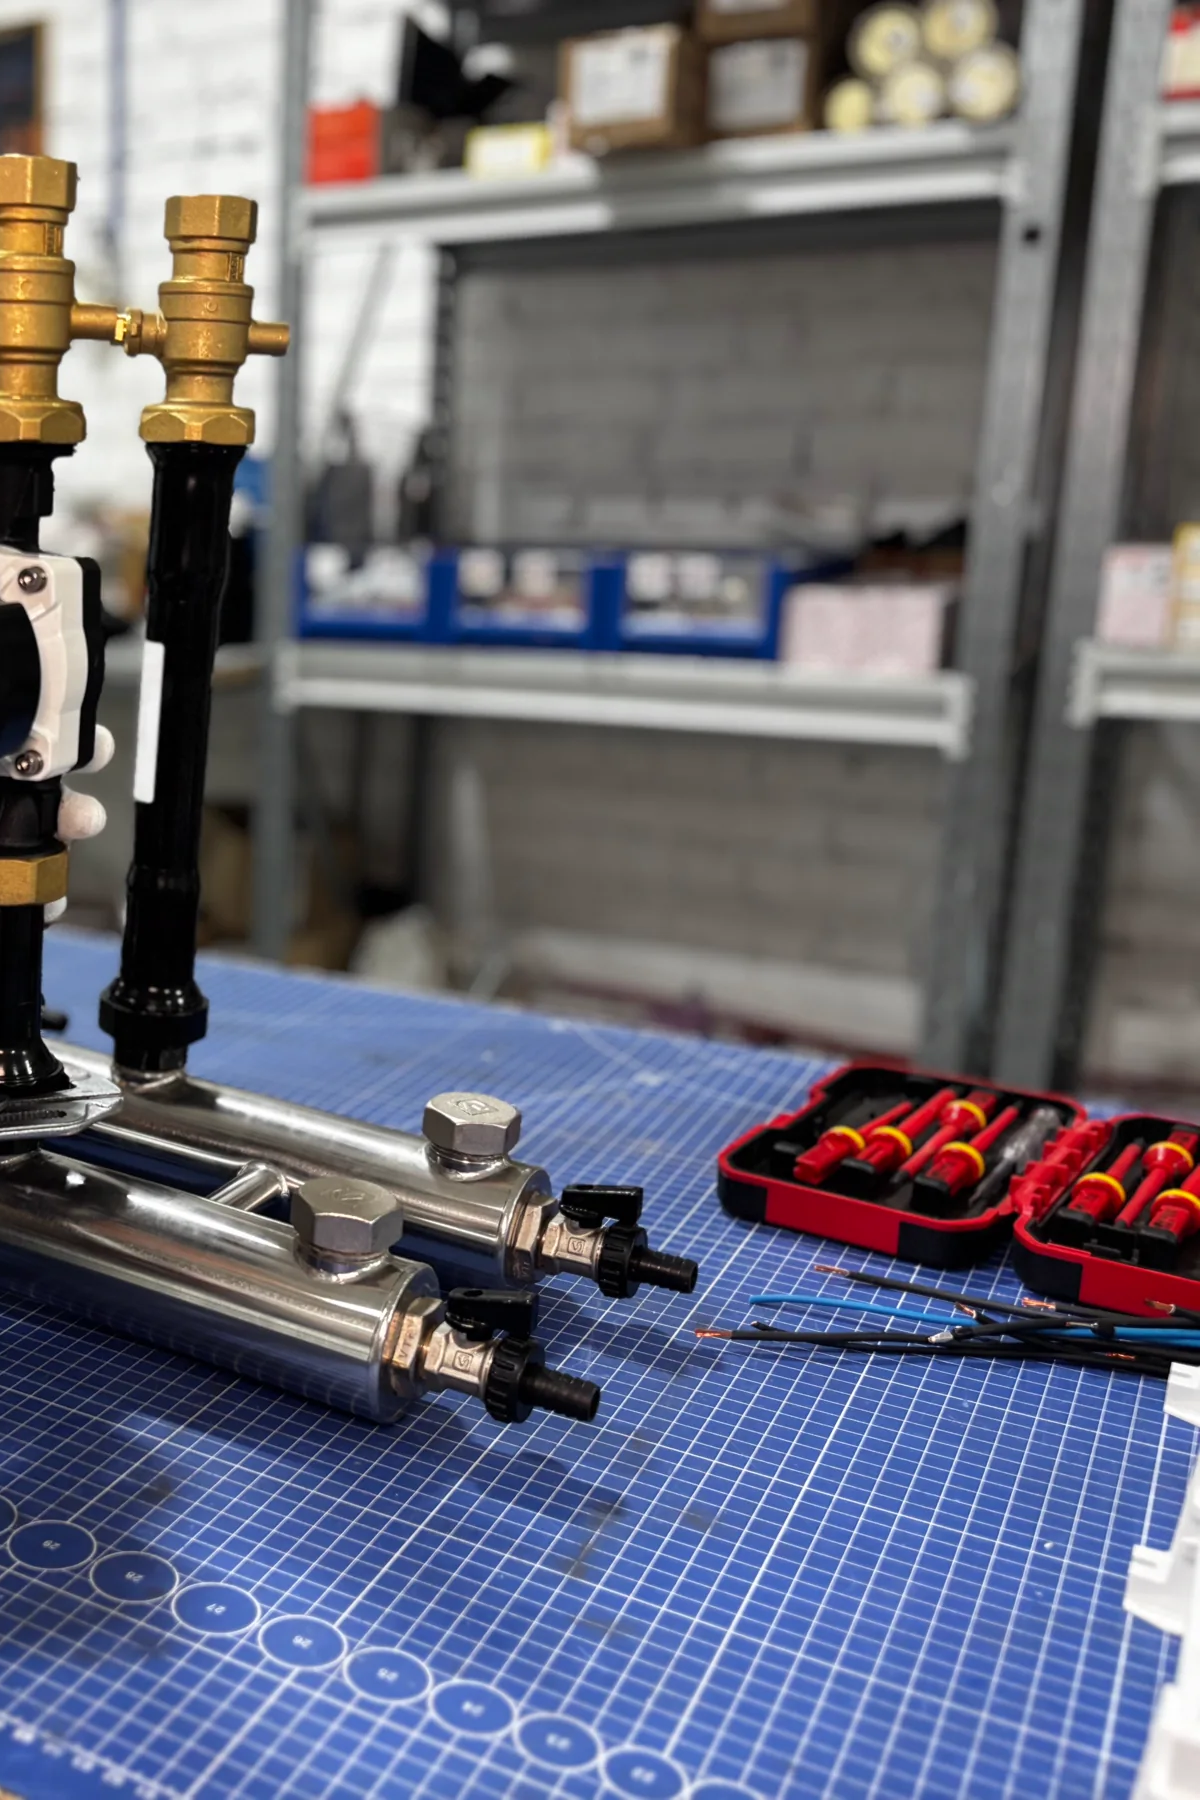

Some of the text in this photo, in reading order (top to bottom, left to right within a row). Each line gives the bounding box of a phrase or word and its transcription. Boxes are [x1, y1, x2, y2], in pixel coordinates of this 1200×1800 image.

[42, 1540, 61, 1551] 29
[125, 1571, 144, 1583] 28
[205, 1603, 226, 1615] 27
